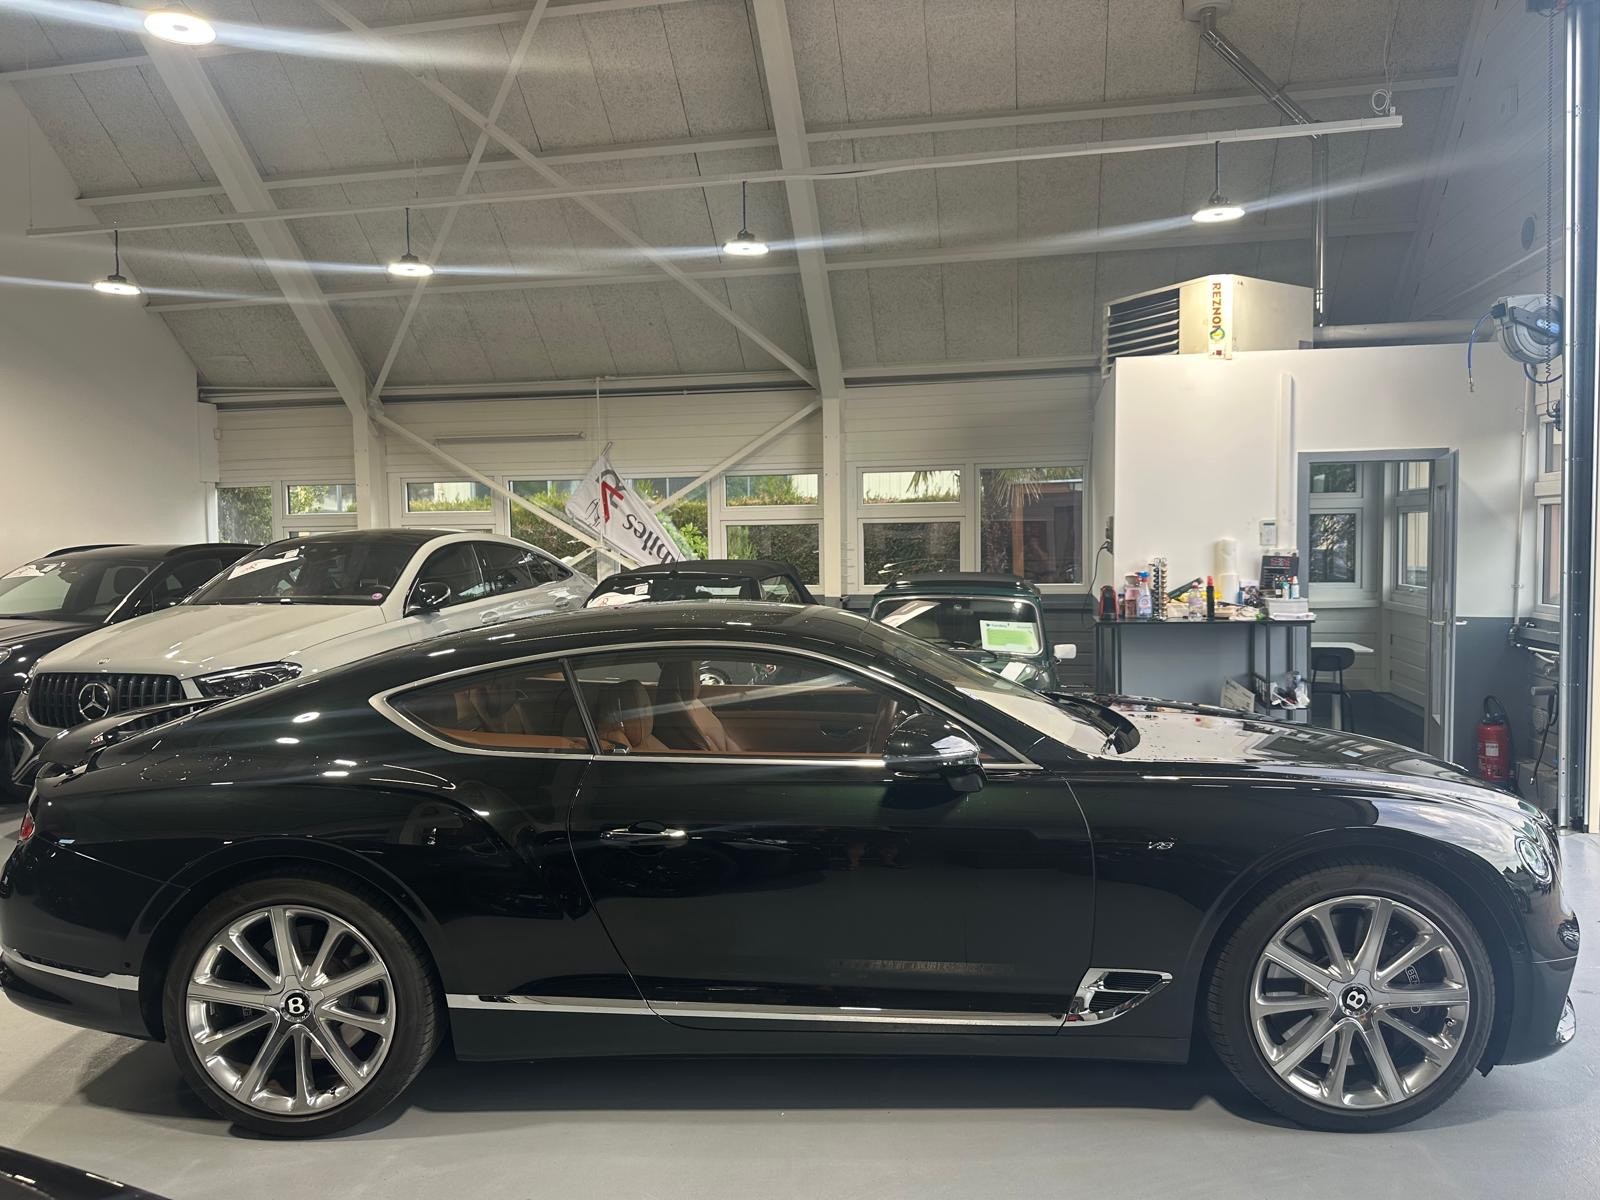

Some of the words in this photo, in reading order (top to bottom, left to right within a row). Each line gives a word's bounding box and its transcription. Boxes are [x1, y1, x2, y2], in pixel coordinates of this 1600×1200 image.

[622, 513, 675, 565] biles
[287, 996, 305, 1014] B
[1346, 990, 1366, 1009] B
